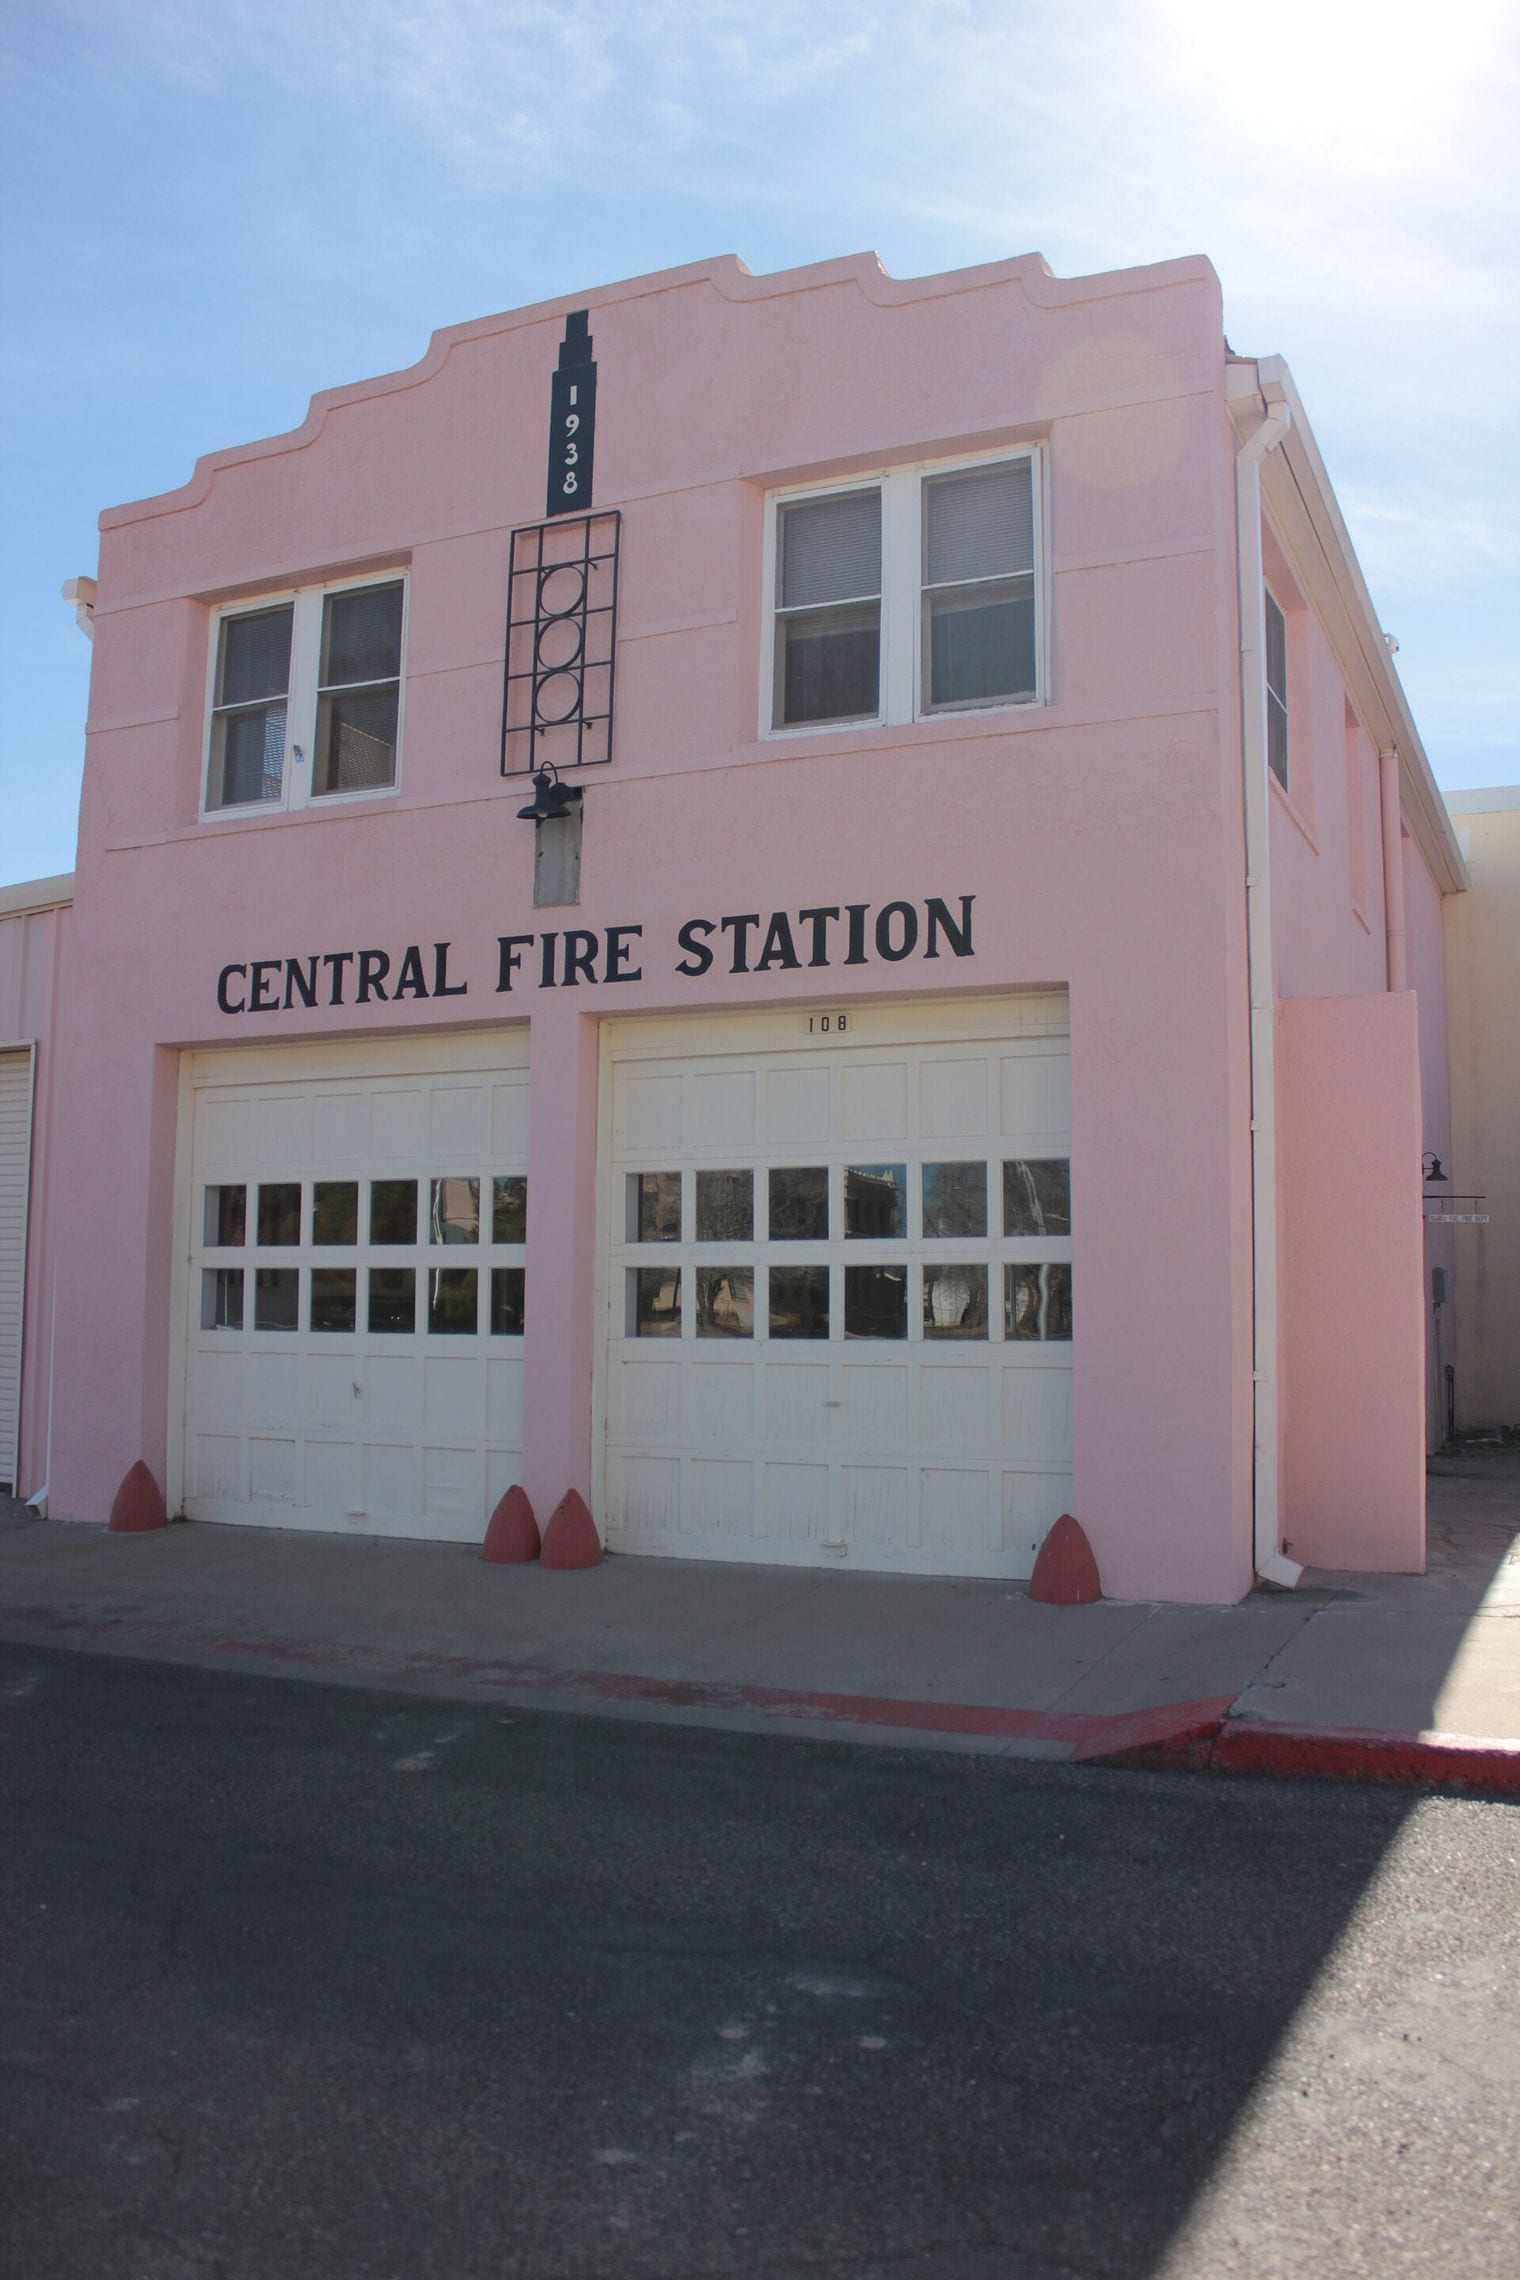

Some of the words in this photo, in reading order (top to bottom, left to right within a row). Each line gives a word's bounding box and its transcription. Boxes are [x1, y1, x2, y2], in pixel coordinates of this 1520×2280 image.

[562, 385, 580, 495] 1938
[217, 942, 468, 1015] CENTRAL
[495, 924, 643, 993] FIRE
[674, 894, 977, 977] STATION
[808, 1015, 847, 1033] 108
